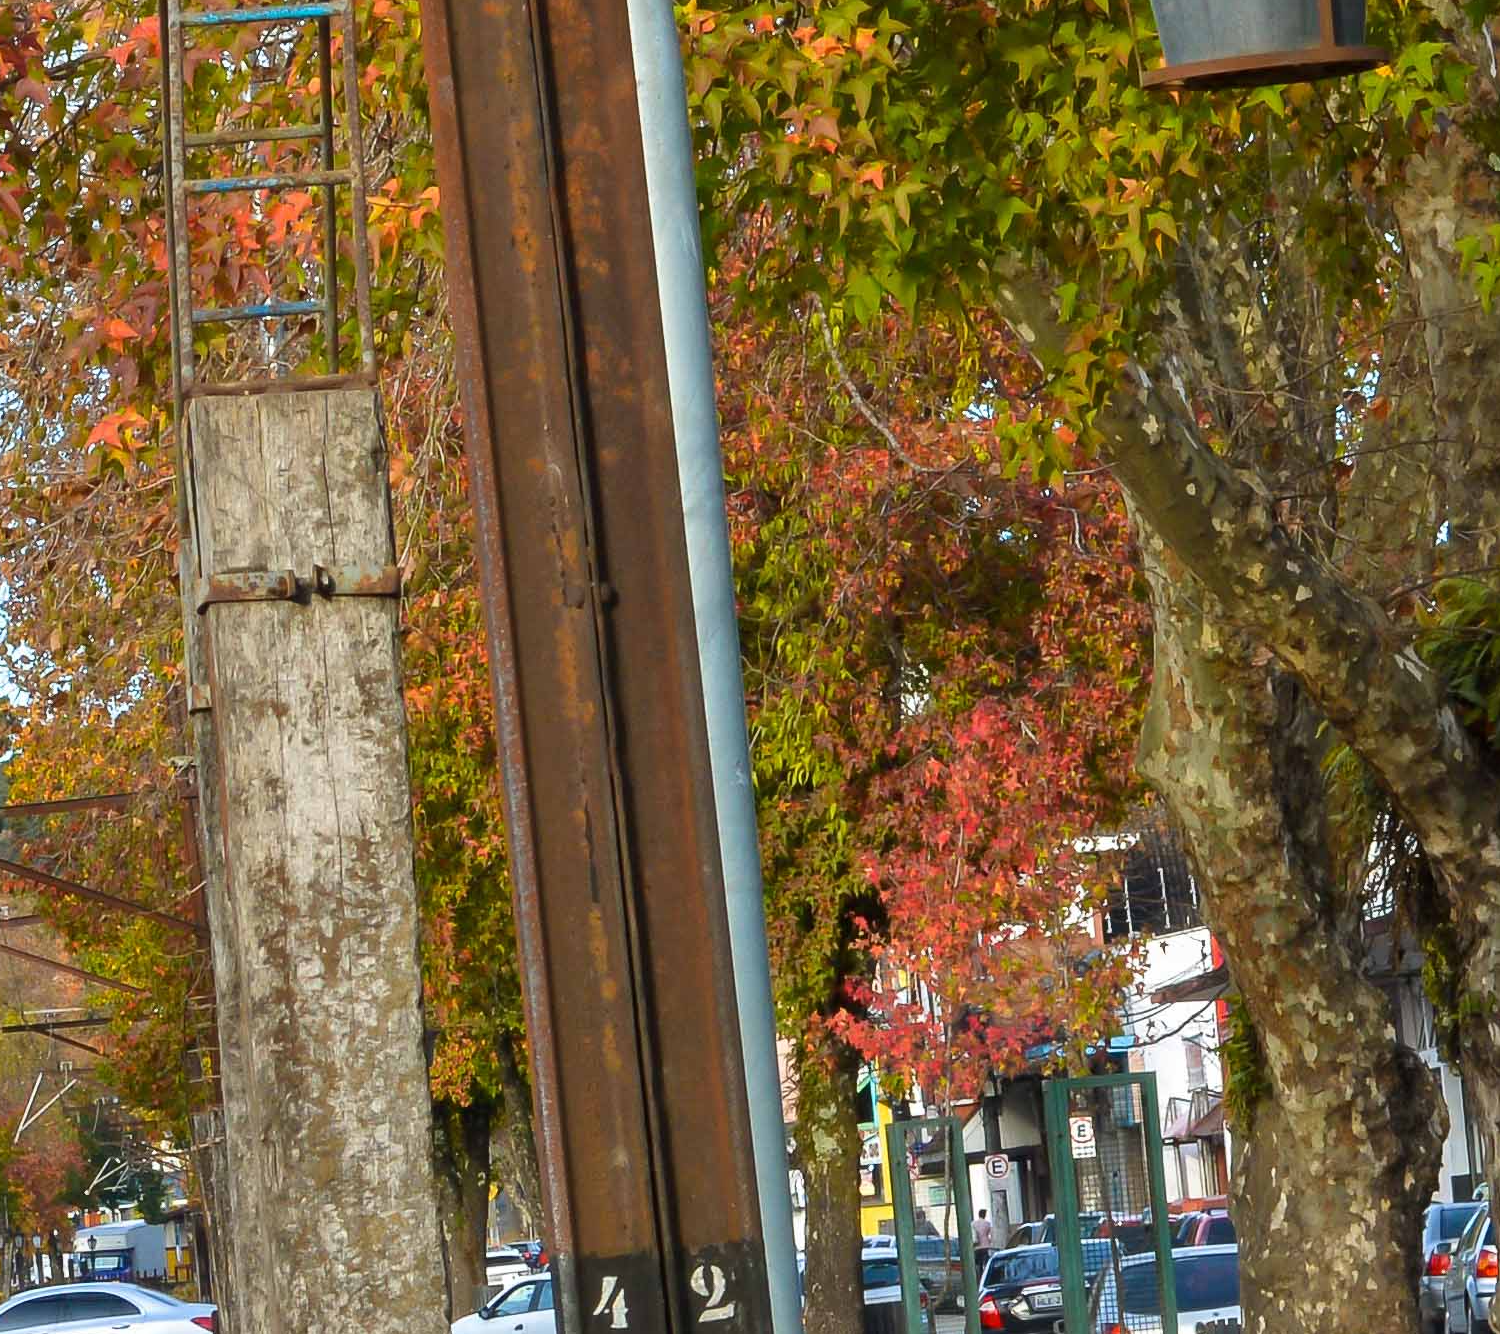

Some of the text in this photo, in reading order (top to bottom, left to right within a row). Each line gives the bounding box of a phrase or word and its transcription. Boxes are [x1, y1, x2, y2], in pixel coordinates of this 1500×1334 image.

[992, 1159, 1004, 1174] E
[592, 1265, 736, 1329] 4 2
